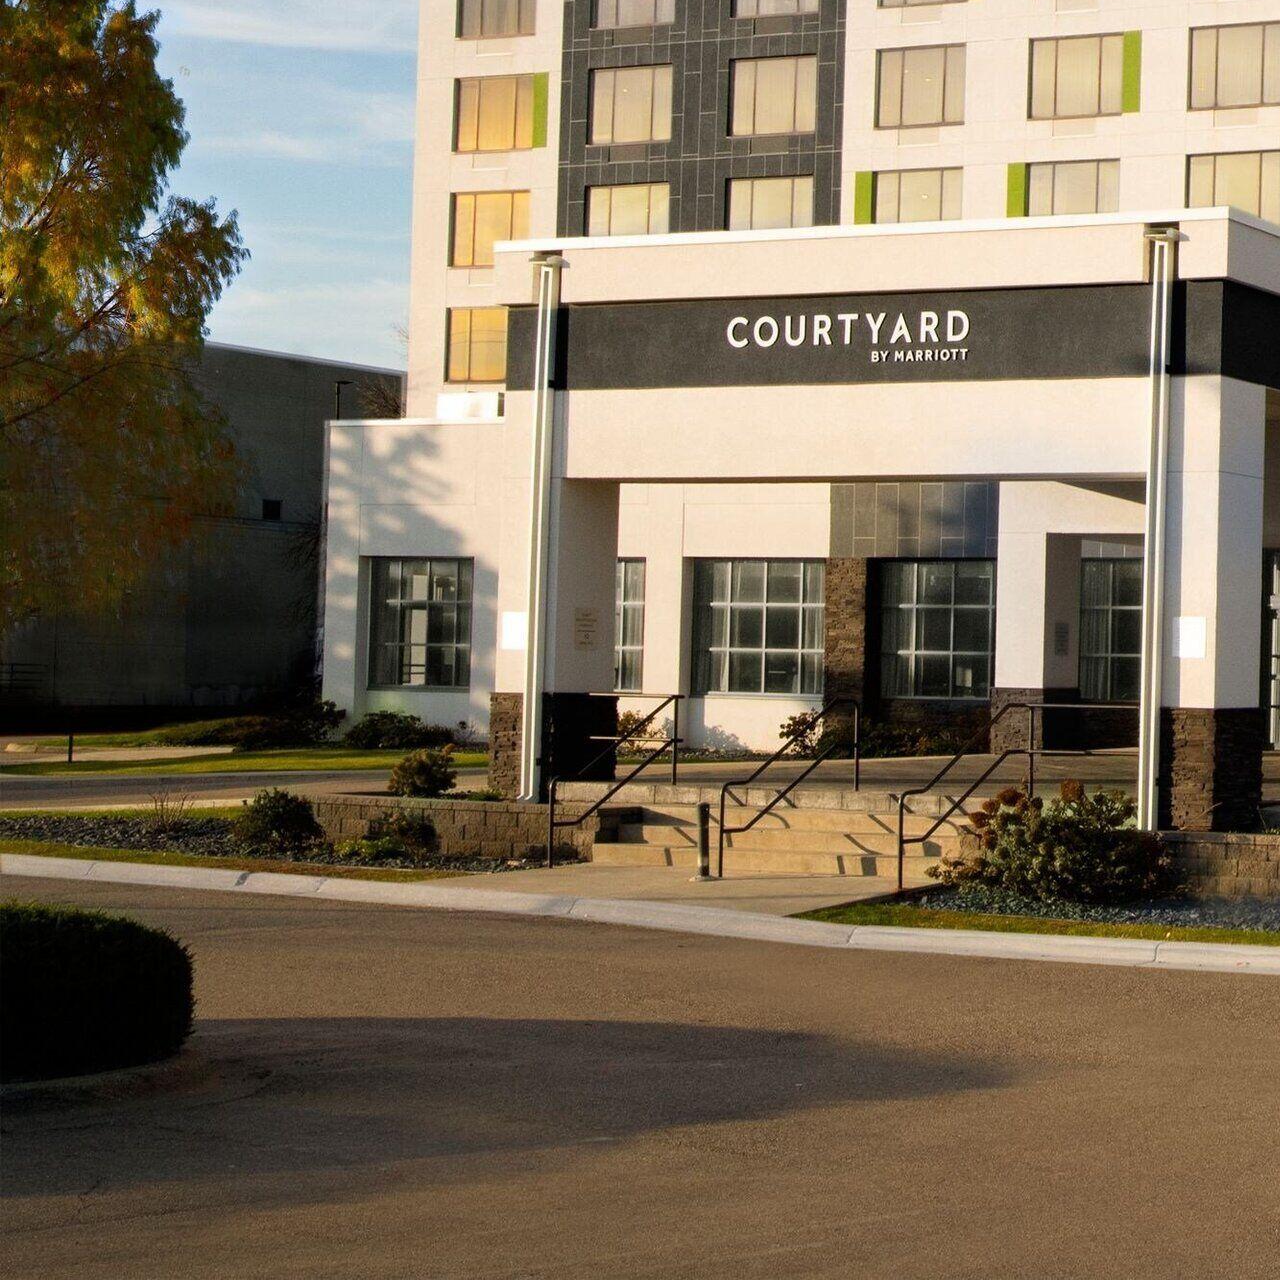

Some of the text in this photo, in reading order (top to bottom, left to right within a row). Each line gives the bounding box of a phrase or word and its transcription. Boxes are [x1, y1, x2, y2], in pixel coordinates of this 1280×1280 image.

[726, 309, 971, 348] COURTYARD
[870, 348, 969, 363] BY MARRIOTT
